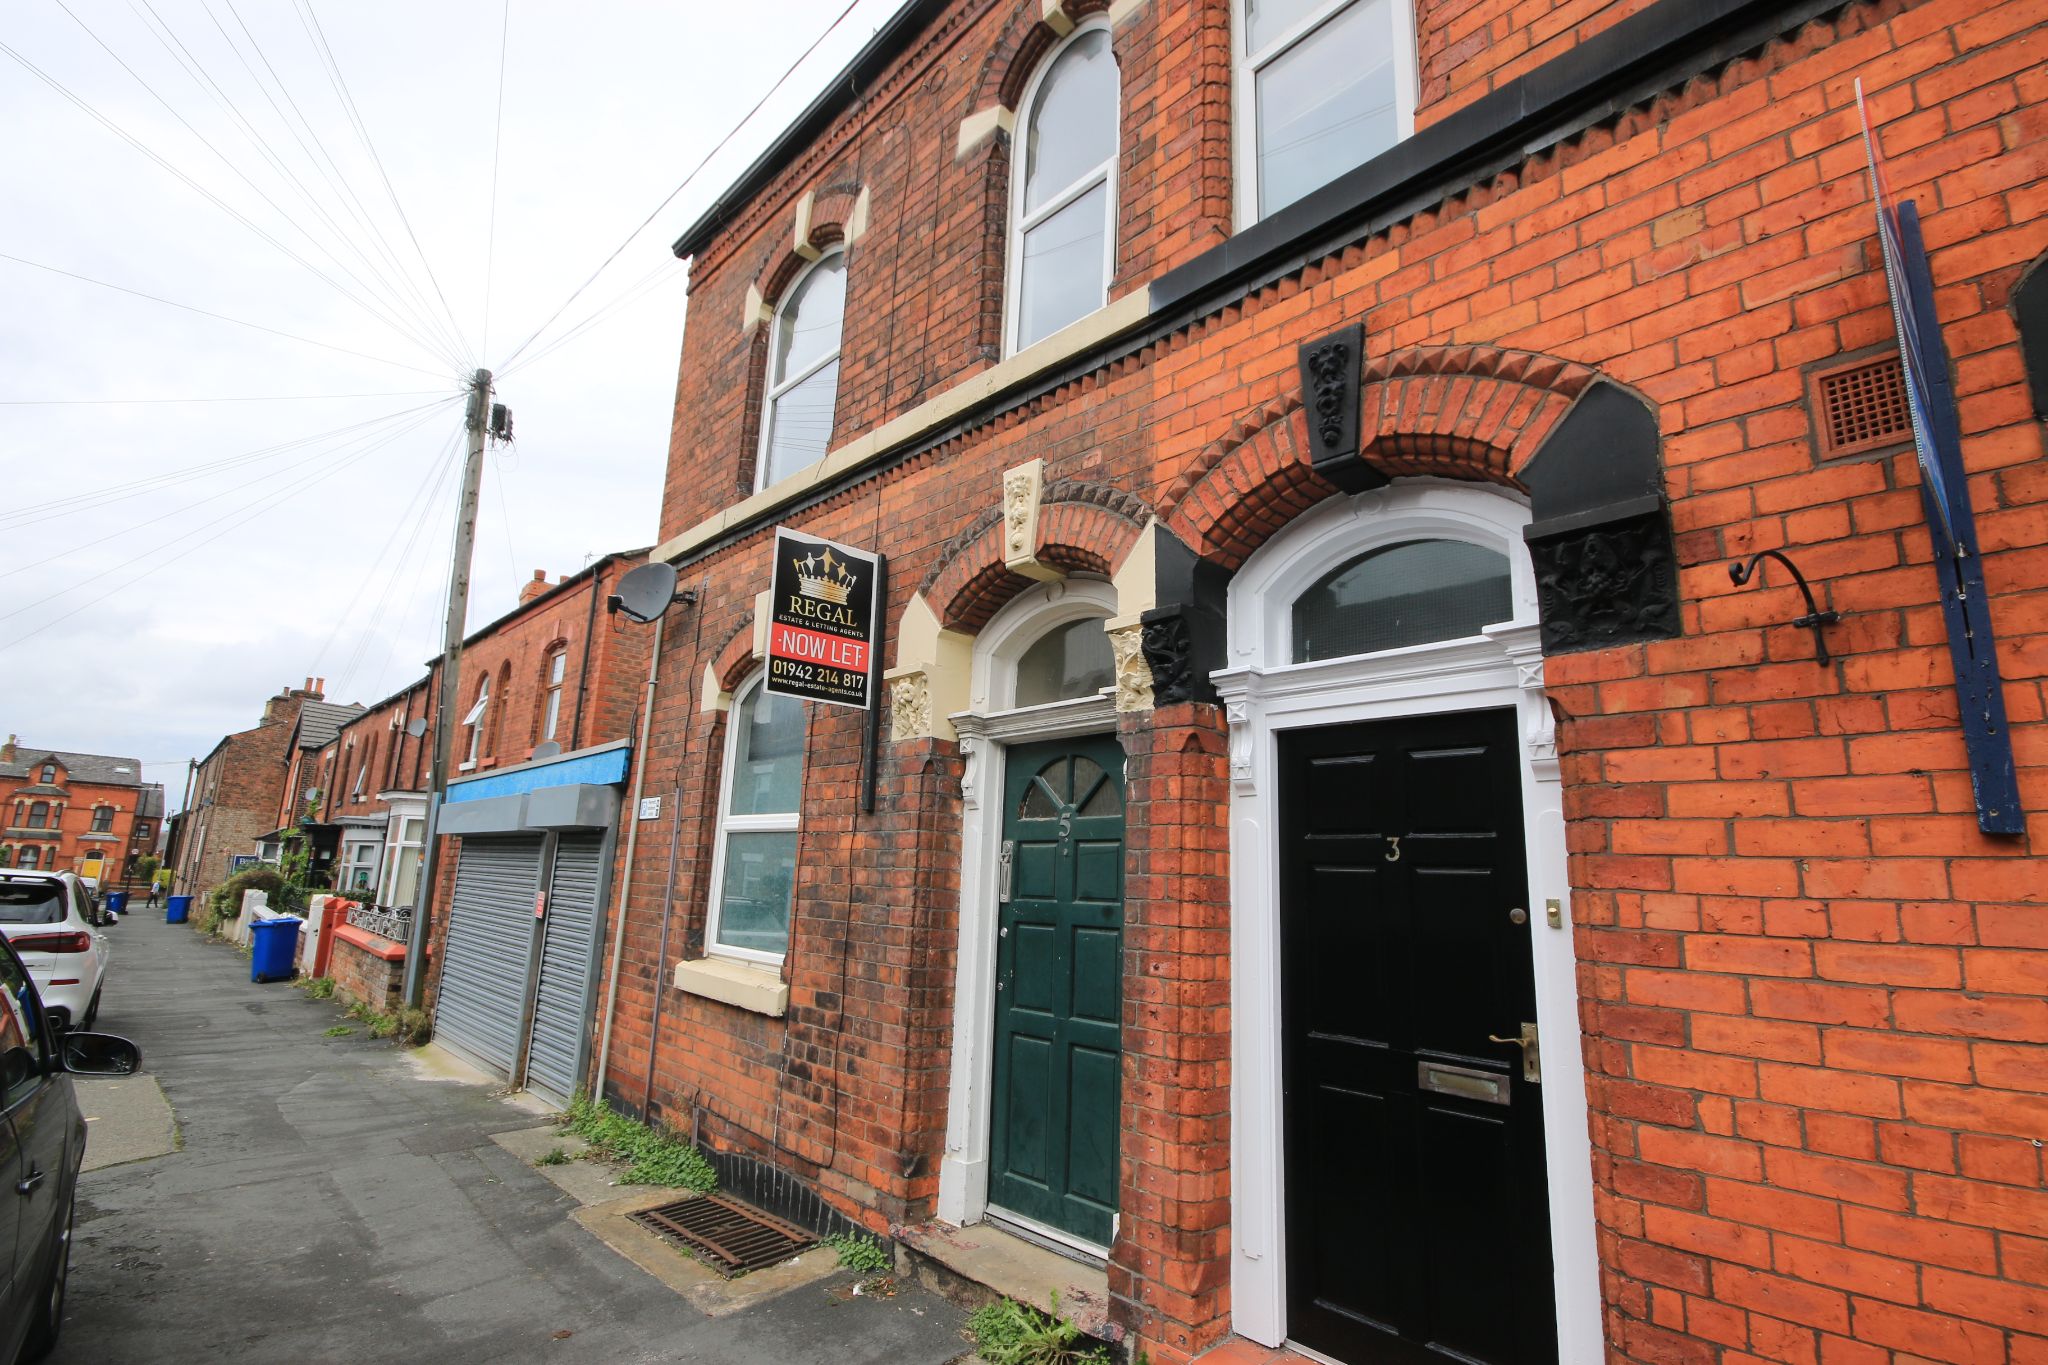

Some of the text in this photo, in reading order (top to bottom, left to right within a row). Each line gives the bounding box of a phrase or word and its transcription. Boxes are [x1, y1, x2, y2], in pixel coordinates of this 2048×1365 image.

[788, 595, 858, 627] REGAL
[778, 614, 803, 625] ESTATE
[811, 622, 838, 633] LETTING
[839, 628, 864, 638] AGENTS
[782, 630, 864, 667] NOW LET
[771, 676, 863, 698] www.regal-estate-agents.co.uk
[773, 659, 864, 689] 01942 214 817
[1058, 812, 1072, 837] 5
[1385, 836, 1400, 862] 3
